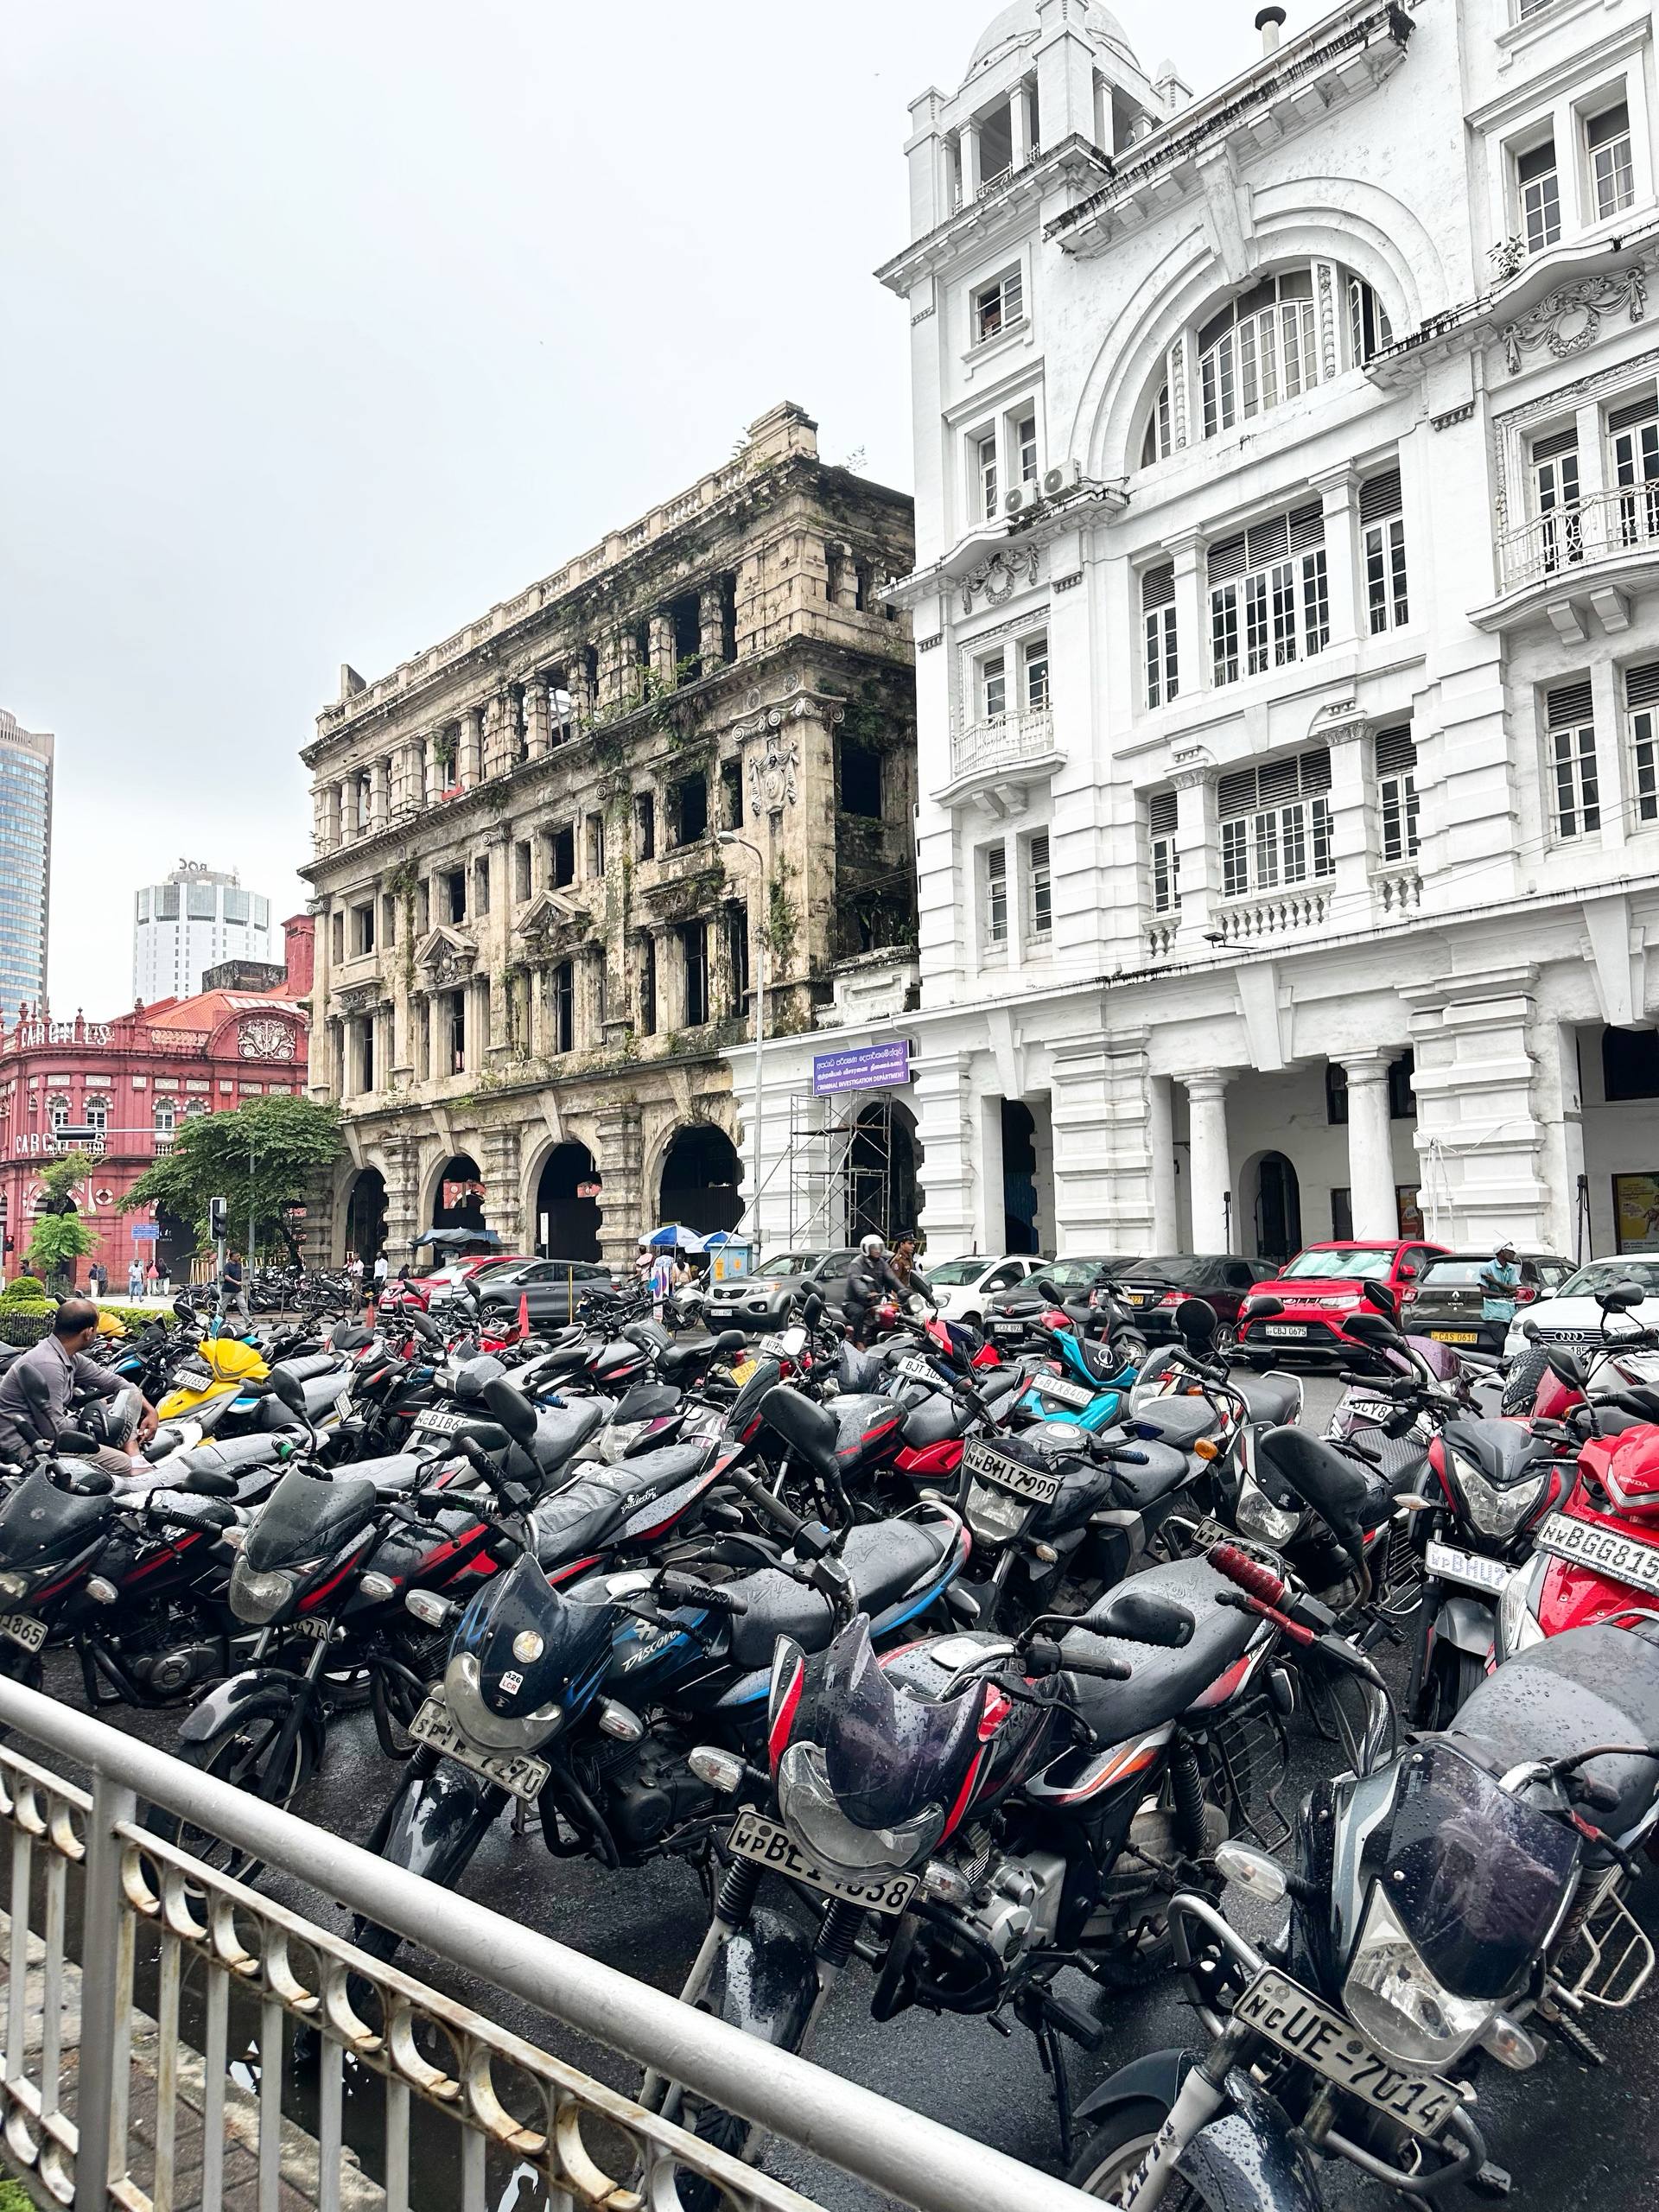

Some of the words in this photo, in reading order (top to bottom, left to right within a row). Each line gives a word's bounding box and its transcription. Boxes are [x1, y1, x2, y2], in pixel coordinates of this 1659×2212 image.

[22, 1023, 107, 1048] CARGILLS
[817, 1083, 838, 1091] CRIMINAL
[838, 1077, 873, 1089] INVESTIGATION
[873, 1071, 905, 1082] DEPARTMENT
[1288, 1327, 1306, 1336] 0675
[1439, 1332, 1454, 1341] CAS
[1457, 1333, 1477, 1342] 0618
[905, 1360, 925, 1374] BJT
[428, 1414, 468, 1431] BIB6
[966, 1452, 982, 1467] NW
[1618, 1475, 1649, 1489] HONDA
[1197, 1529, 1215, 1543] WP
[1542, 1526, 1567, 1545] NW
[1565, 1525, 1659, 1583] BGG815
[505, 1671, 522, 1684] 326
[502, 1680, 518, 1692] LCR
[735, 1830, 765, 1853] WP
[1244, 1994, 1286, 2030] NC
[1281, 2005, 1449, 2129] UE-7014
